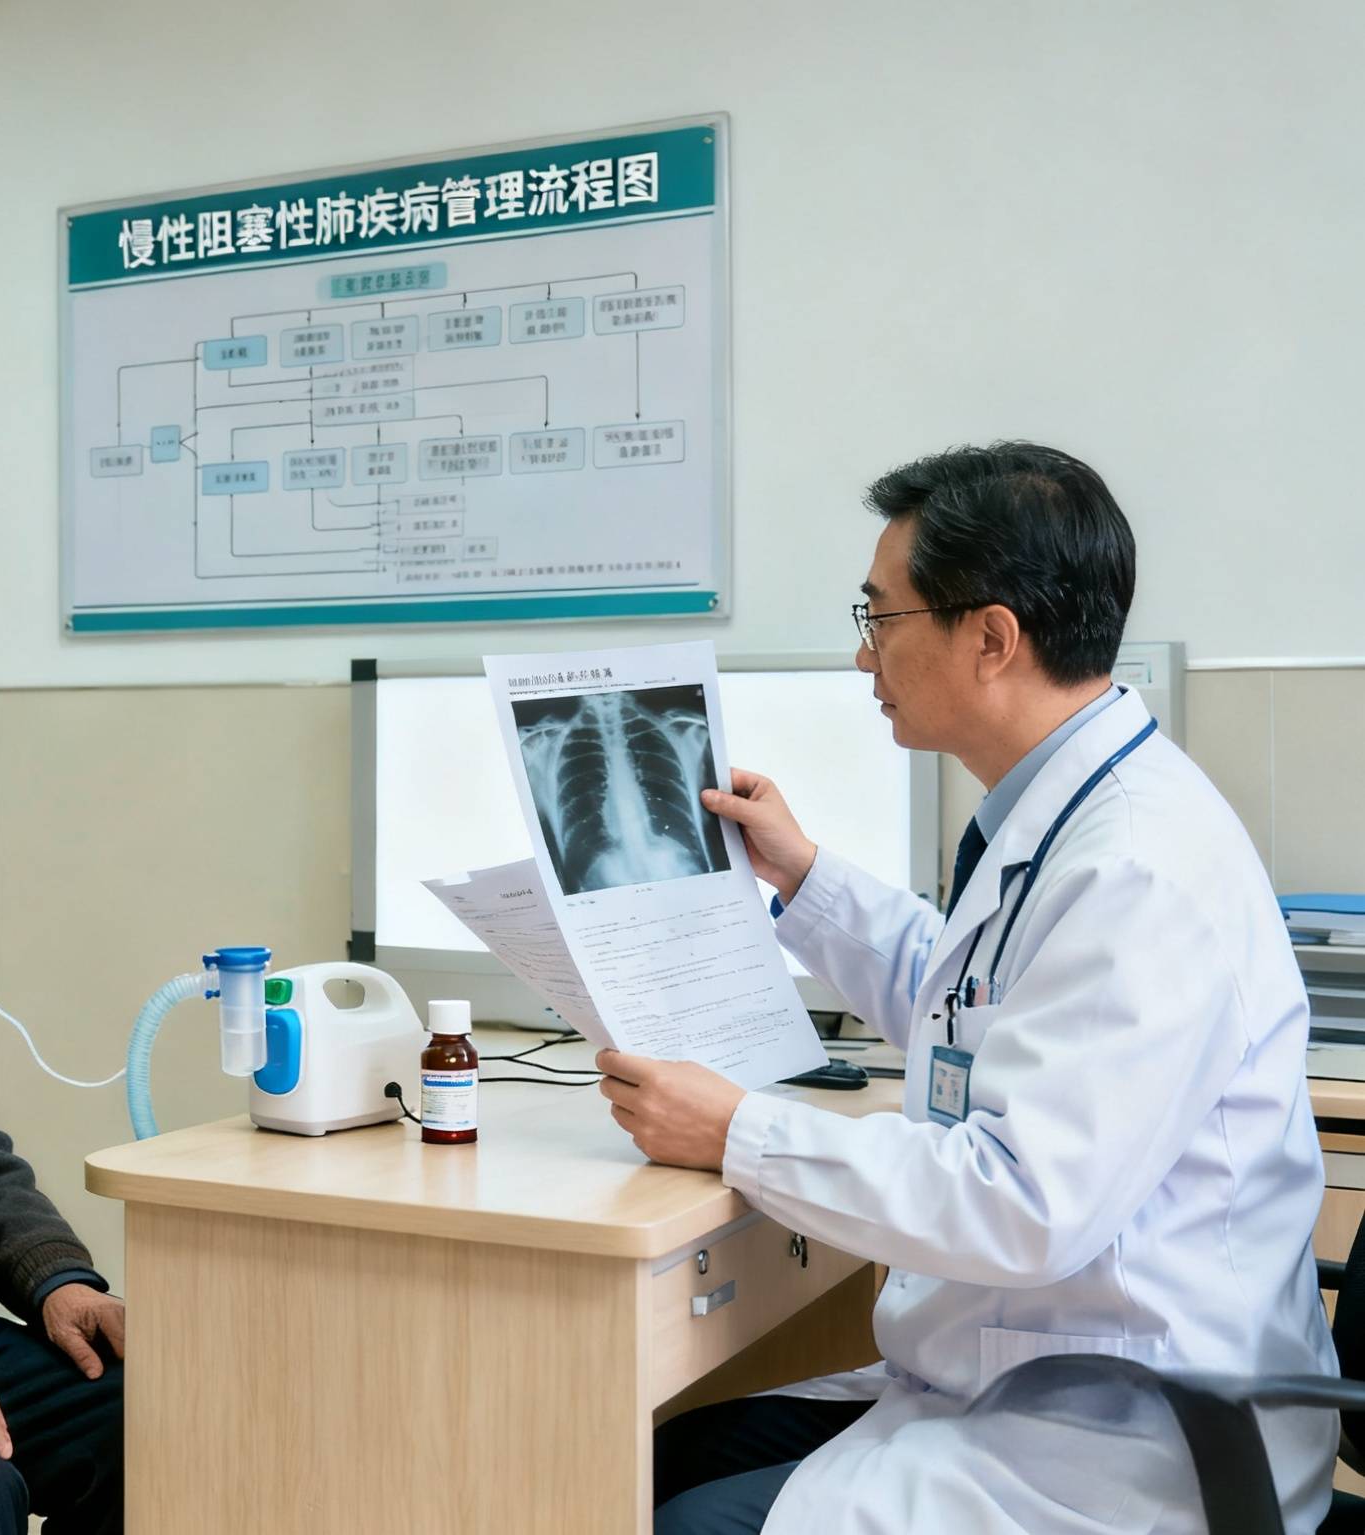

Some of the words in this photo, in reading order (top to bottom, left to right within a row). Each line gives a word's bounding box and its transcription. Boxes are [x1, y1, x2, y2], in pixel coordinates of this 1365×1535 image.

[118, 152, 658, 270] 慢性阻塞性肺疾病管理流程图
